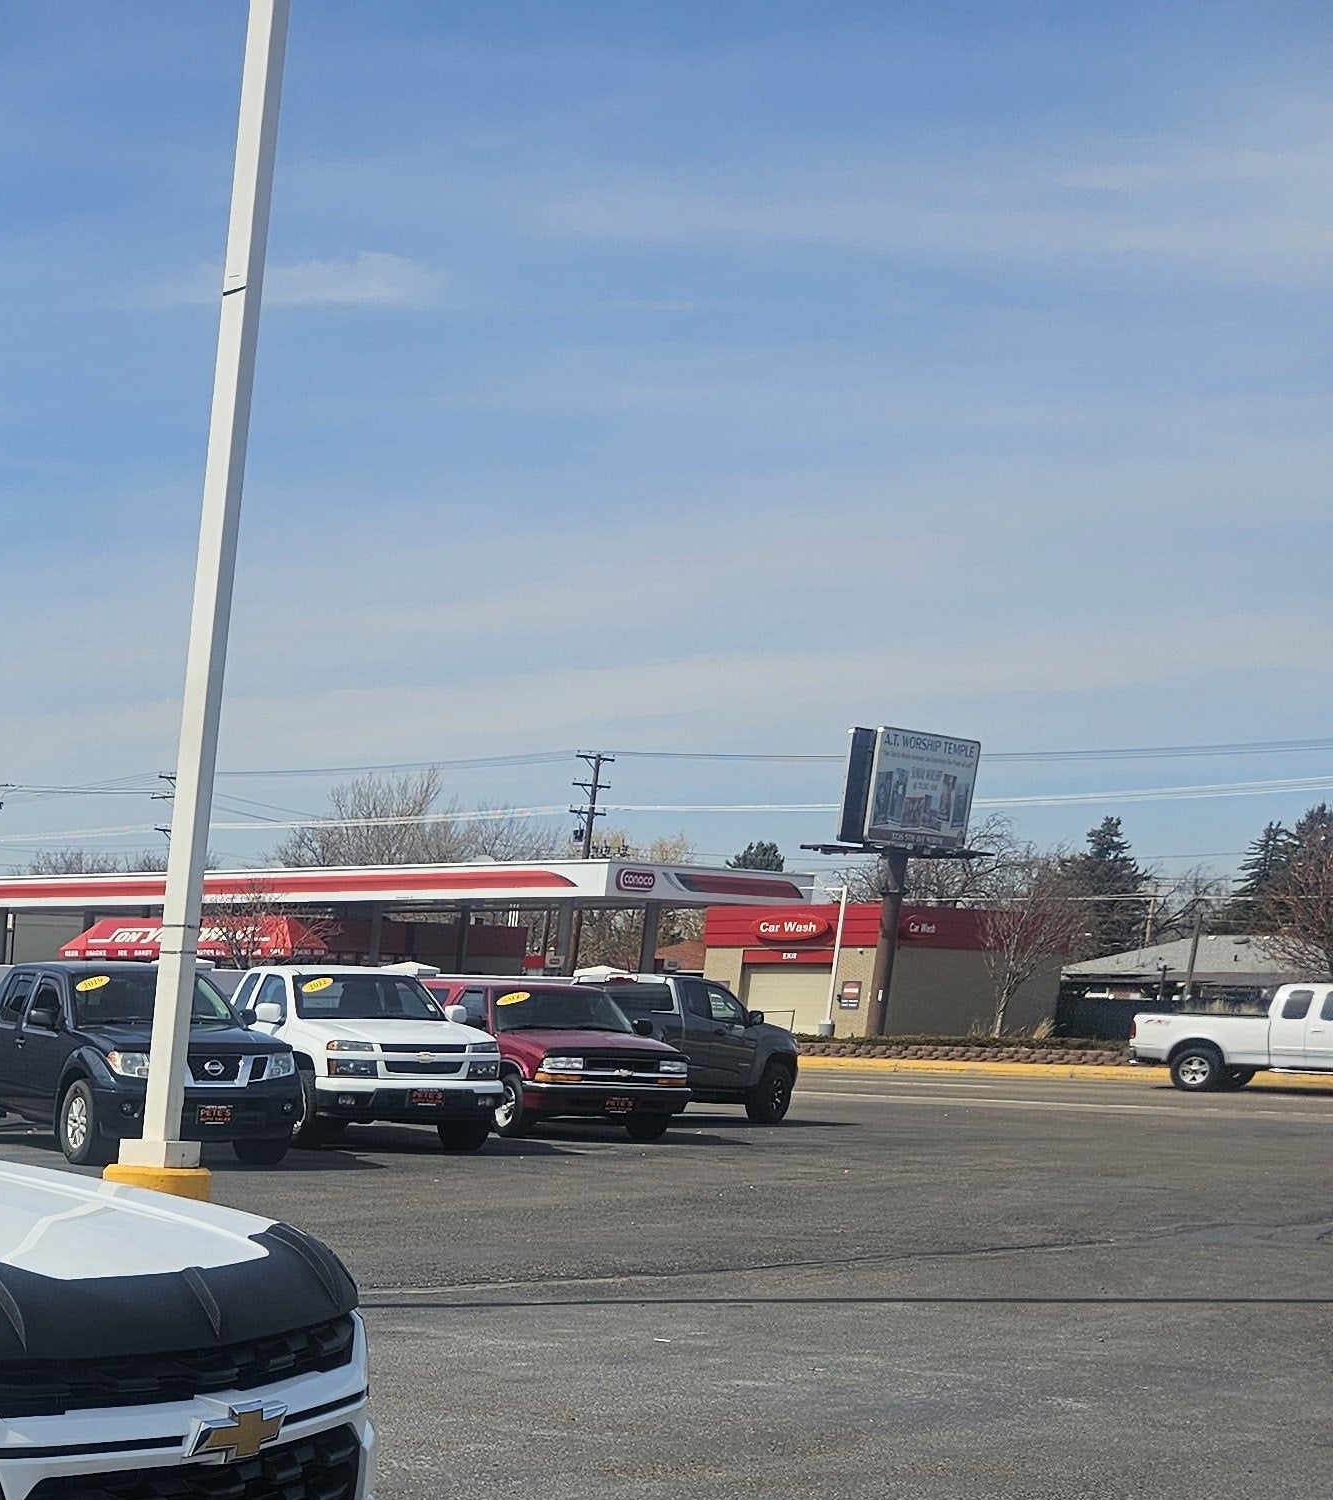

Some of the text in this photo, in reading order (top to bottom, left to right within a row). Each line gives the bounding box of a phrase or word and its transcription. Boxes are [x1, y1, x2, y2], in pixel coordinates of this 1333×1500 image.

[884, 734, 975, 758] A.T. WORSHIP TEMPLE
[624, 875, 653, 886] conoco
[760, 922, 816, 933] Car Wash
[910, 922, 920, 933] Car
